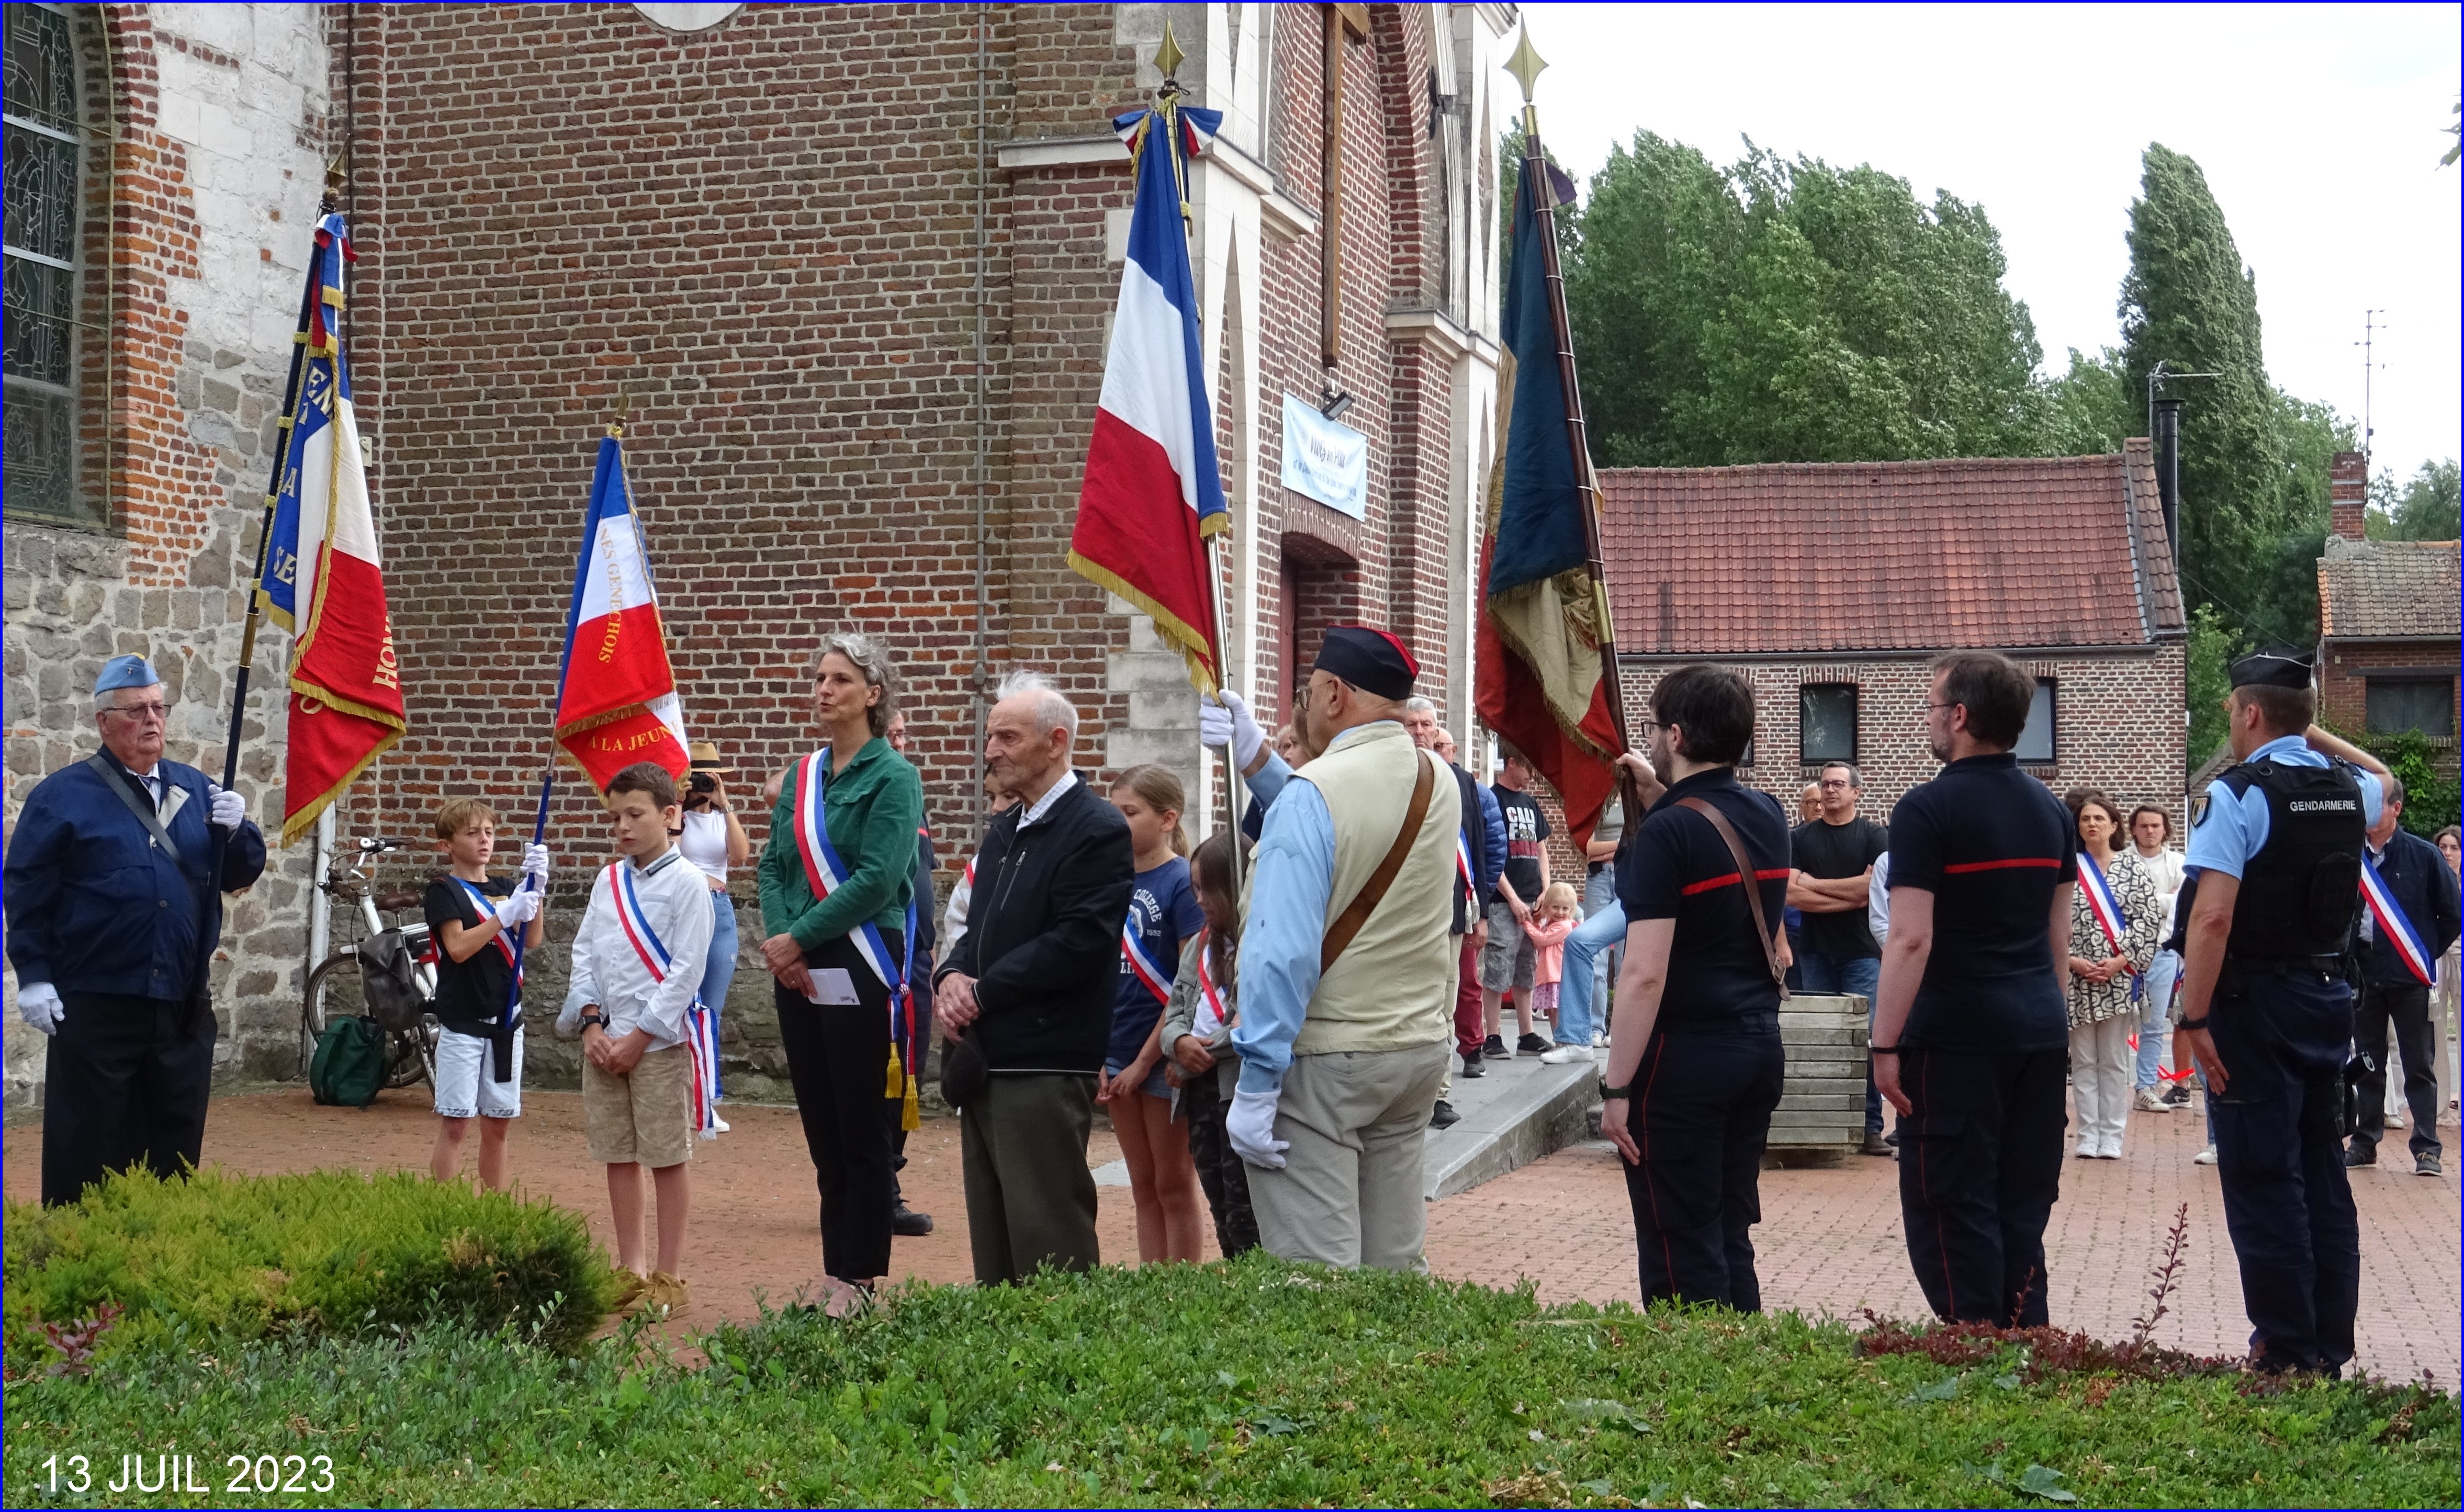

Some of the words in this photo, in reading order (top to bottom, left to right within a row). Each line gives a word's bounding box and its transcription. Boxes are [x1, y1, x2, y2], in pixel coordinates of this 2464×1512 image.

[598, 563, 622, 663] GENECHOIS
[601, 737, 624, 752] LA
[628, 719, 683, 751] JEUNE
[1505, 806, 1536, 825] CALI
[2289, 800, 2357, 812] GENDARMERIE
[1133, 888, 1162, 923] COLLEGE
